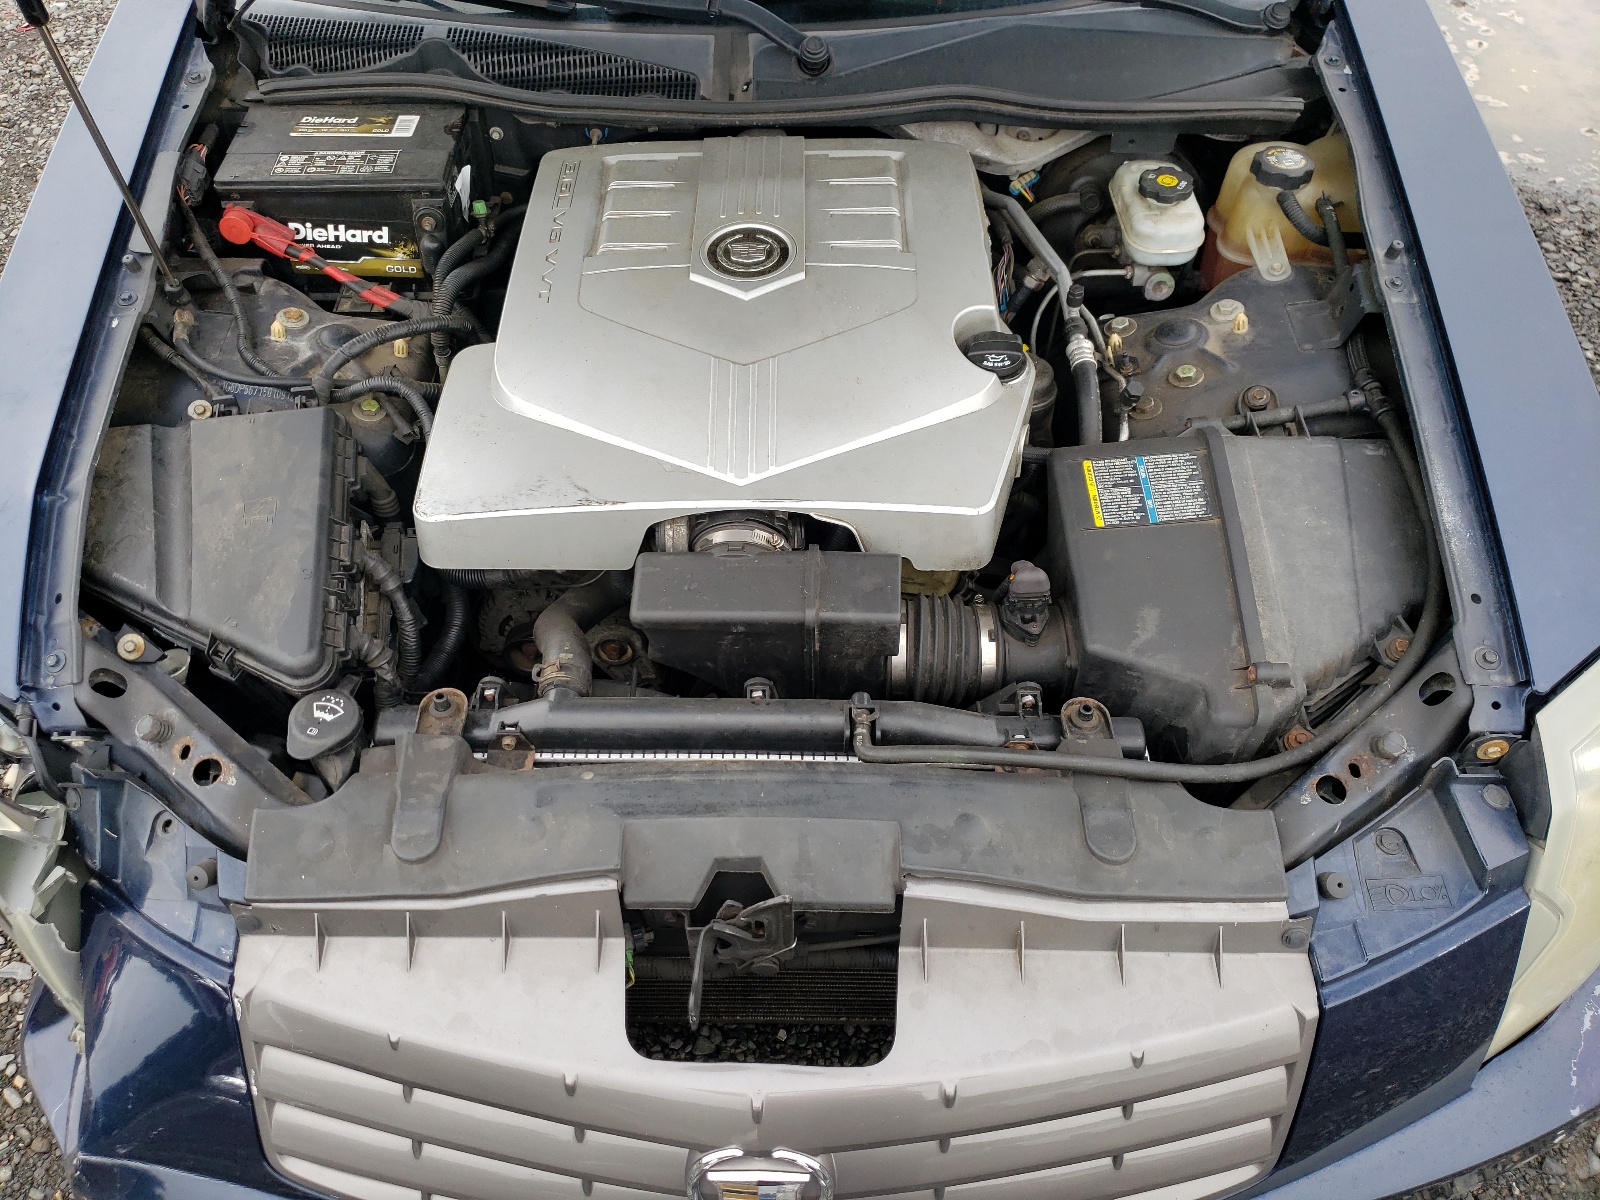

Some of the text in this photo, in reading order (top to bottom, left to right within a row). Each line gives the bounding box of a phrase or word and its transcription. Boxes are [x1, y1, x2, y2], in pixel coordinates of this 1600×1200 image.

[300, 116, 360, 124] DieHard
[288, 222, 389, 244] DieHard
[538, 162, 577, 304] 3.6L V6 VVT
[385, 264, 417, 274] GOLD
